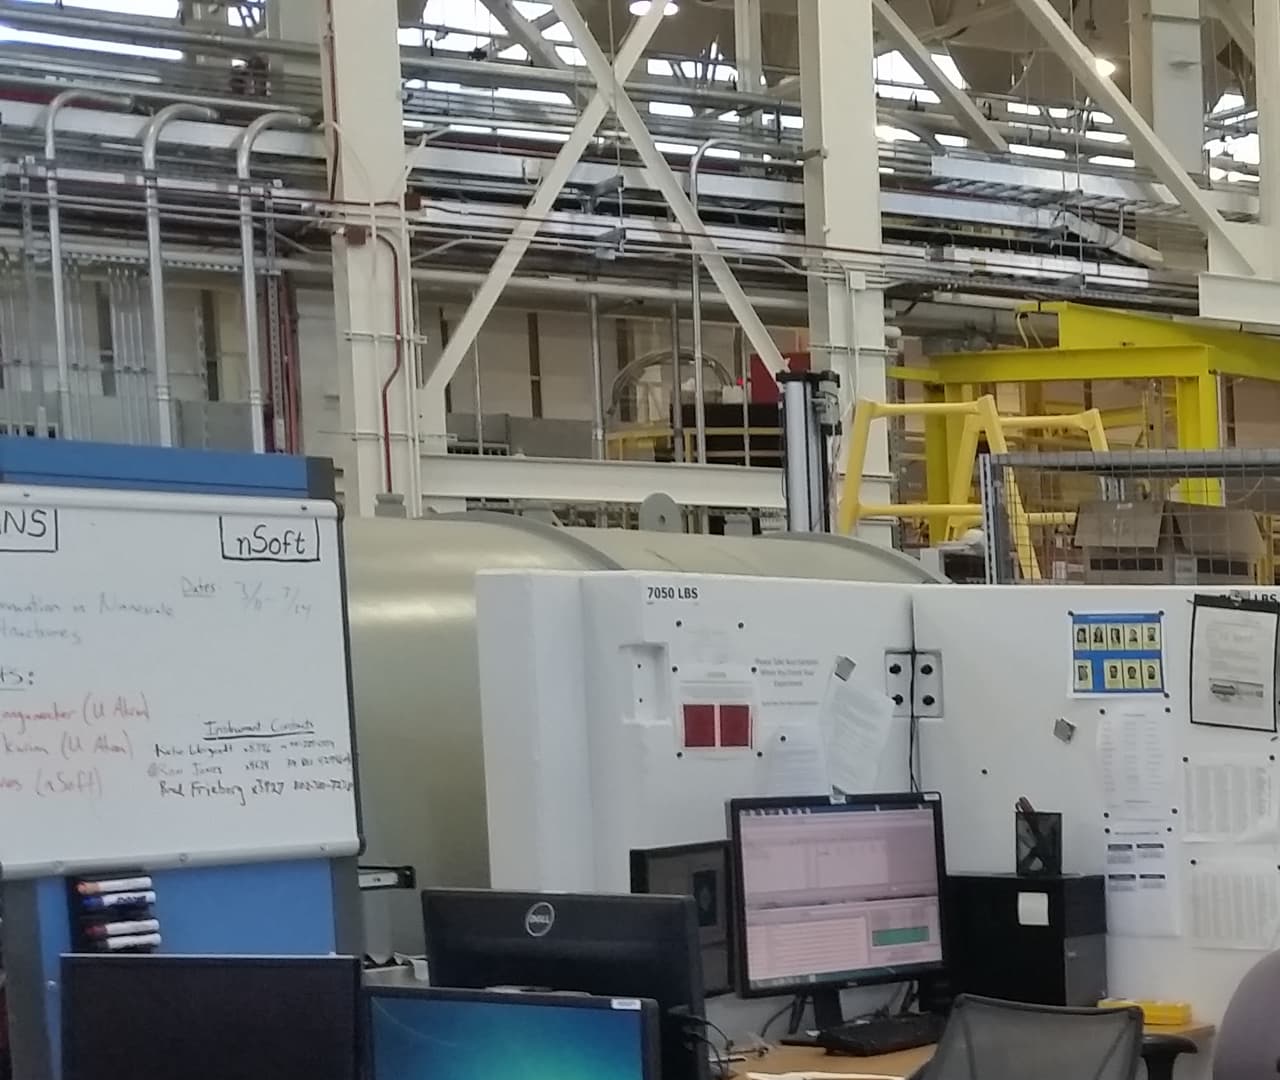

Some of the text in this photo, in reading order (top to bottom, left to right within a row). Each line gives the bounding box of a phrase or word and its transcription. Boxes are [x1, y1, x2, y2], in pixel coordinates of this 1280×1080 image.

[236, 523, 306, 556] nSoft
[647, 586, 698, 600] 7050 LBS
